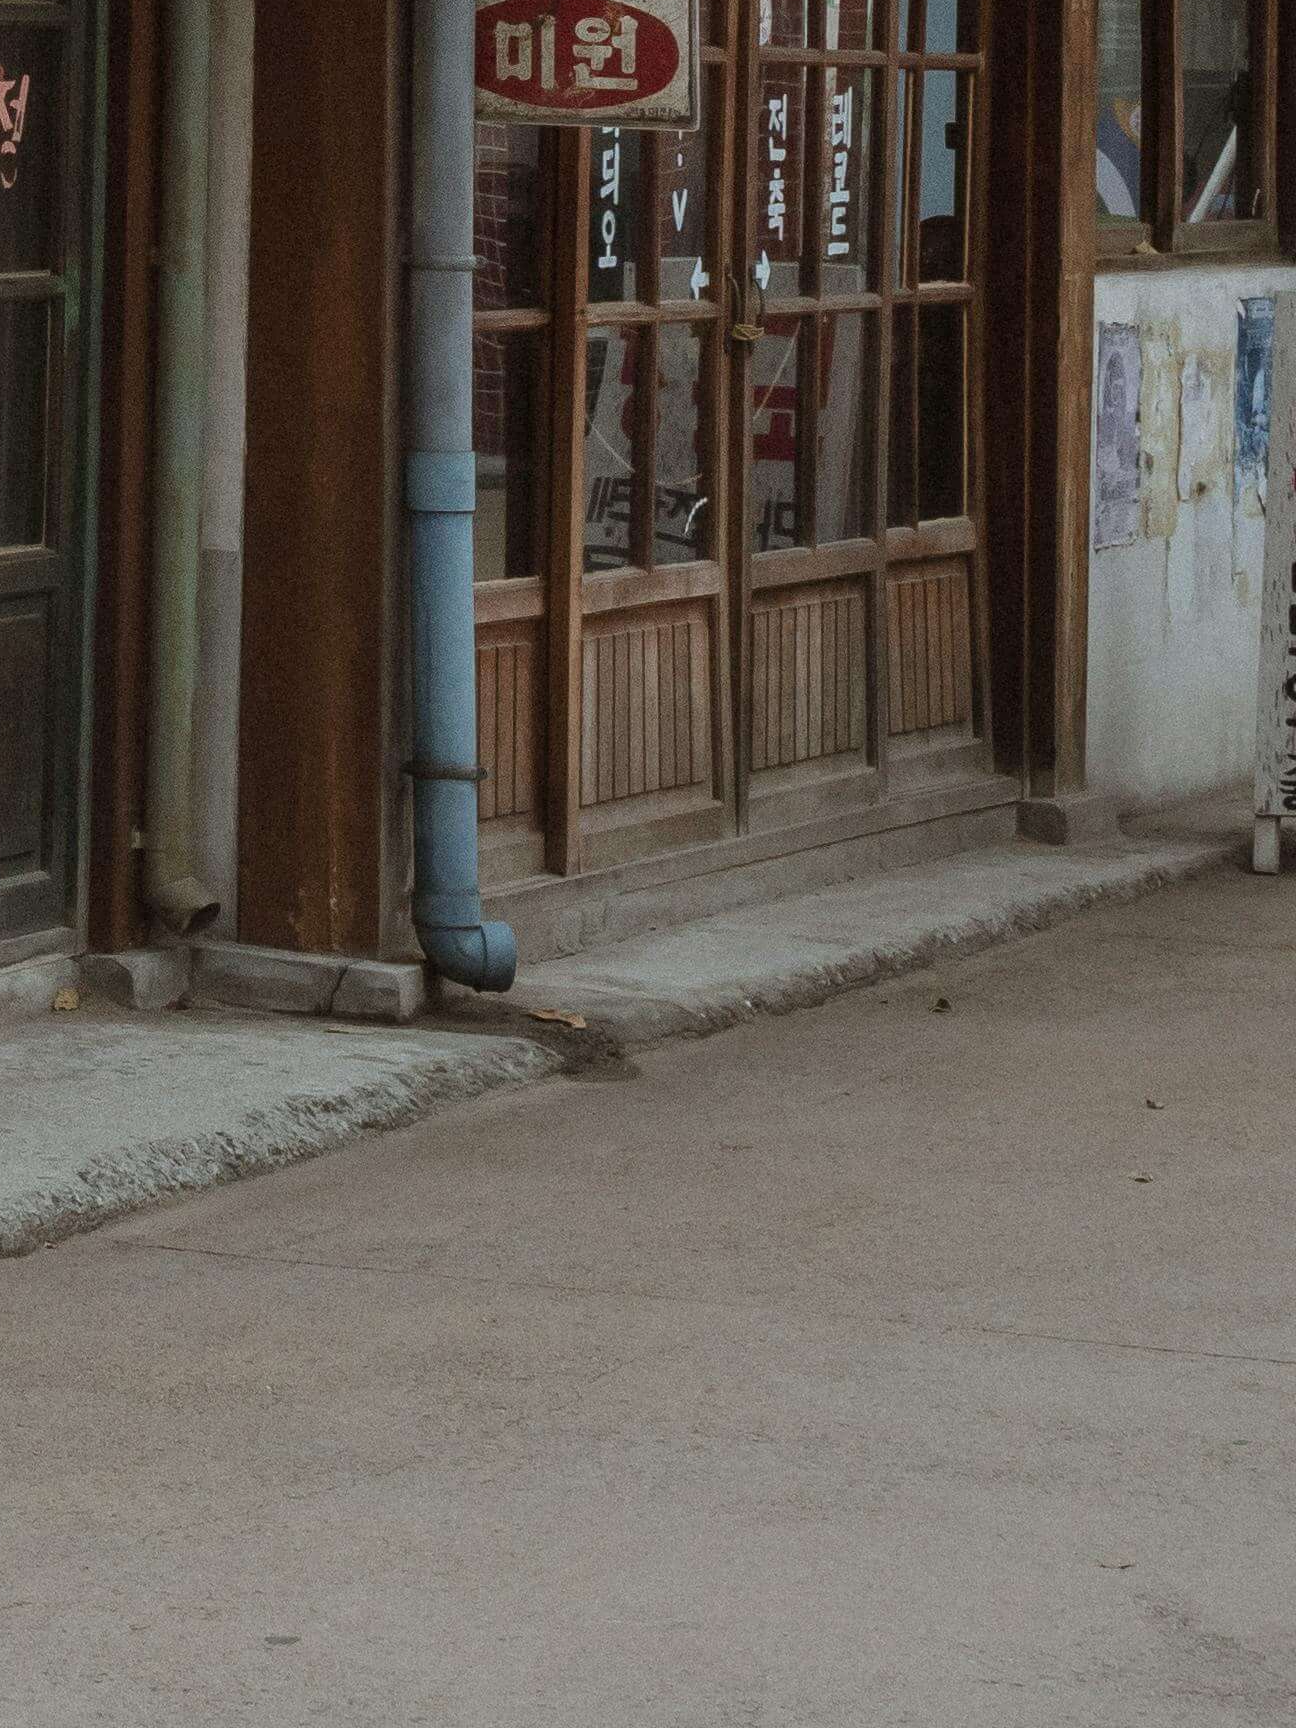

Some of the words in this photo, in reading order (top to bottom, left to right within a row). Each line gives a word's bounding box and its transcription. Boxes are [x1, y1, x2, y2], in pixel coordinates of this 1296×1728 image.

[493, 14, 640, 92] 미원
[767, 92, 789, 242] 전축
[826, 85, 854, 258] 레코드
